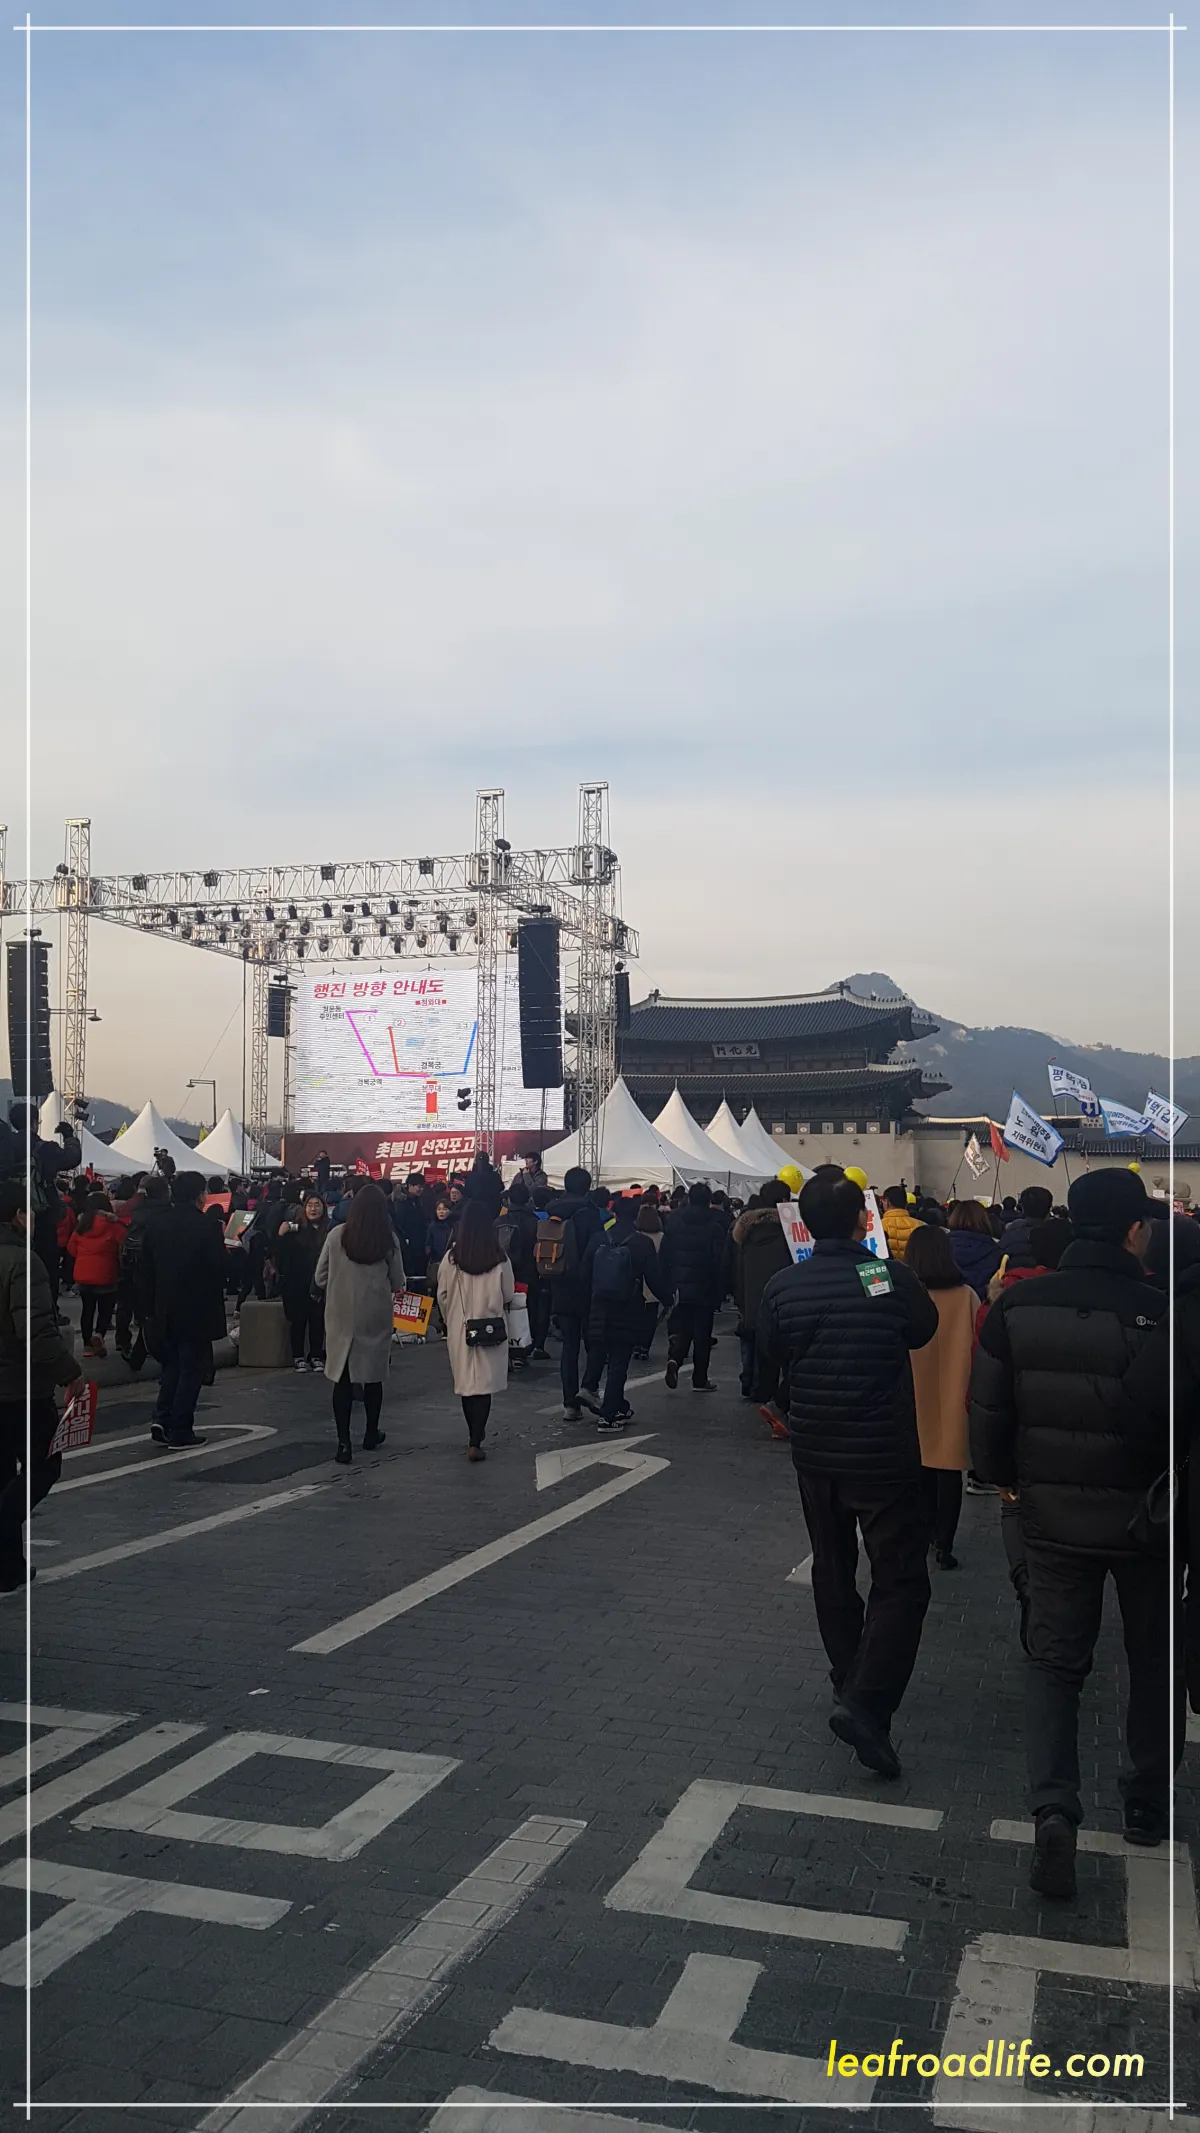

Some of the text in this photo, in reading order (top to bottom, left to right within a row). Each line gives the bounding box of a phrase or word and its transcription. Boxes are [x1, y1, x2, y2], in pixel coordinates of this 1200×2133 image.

[313, 979, 445, 999] 행진 방향 안내도
[375, 1136, 476, 1159] 촛불의 선전포고
[391, 1291, 422, 1307] 근혜를
